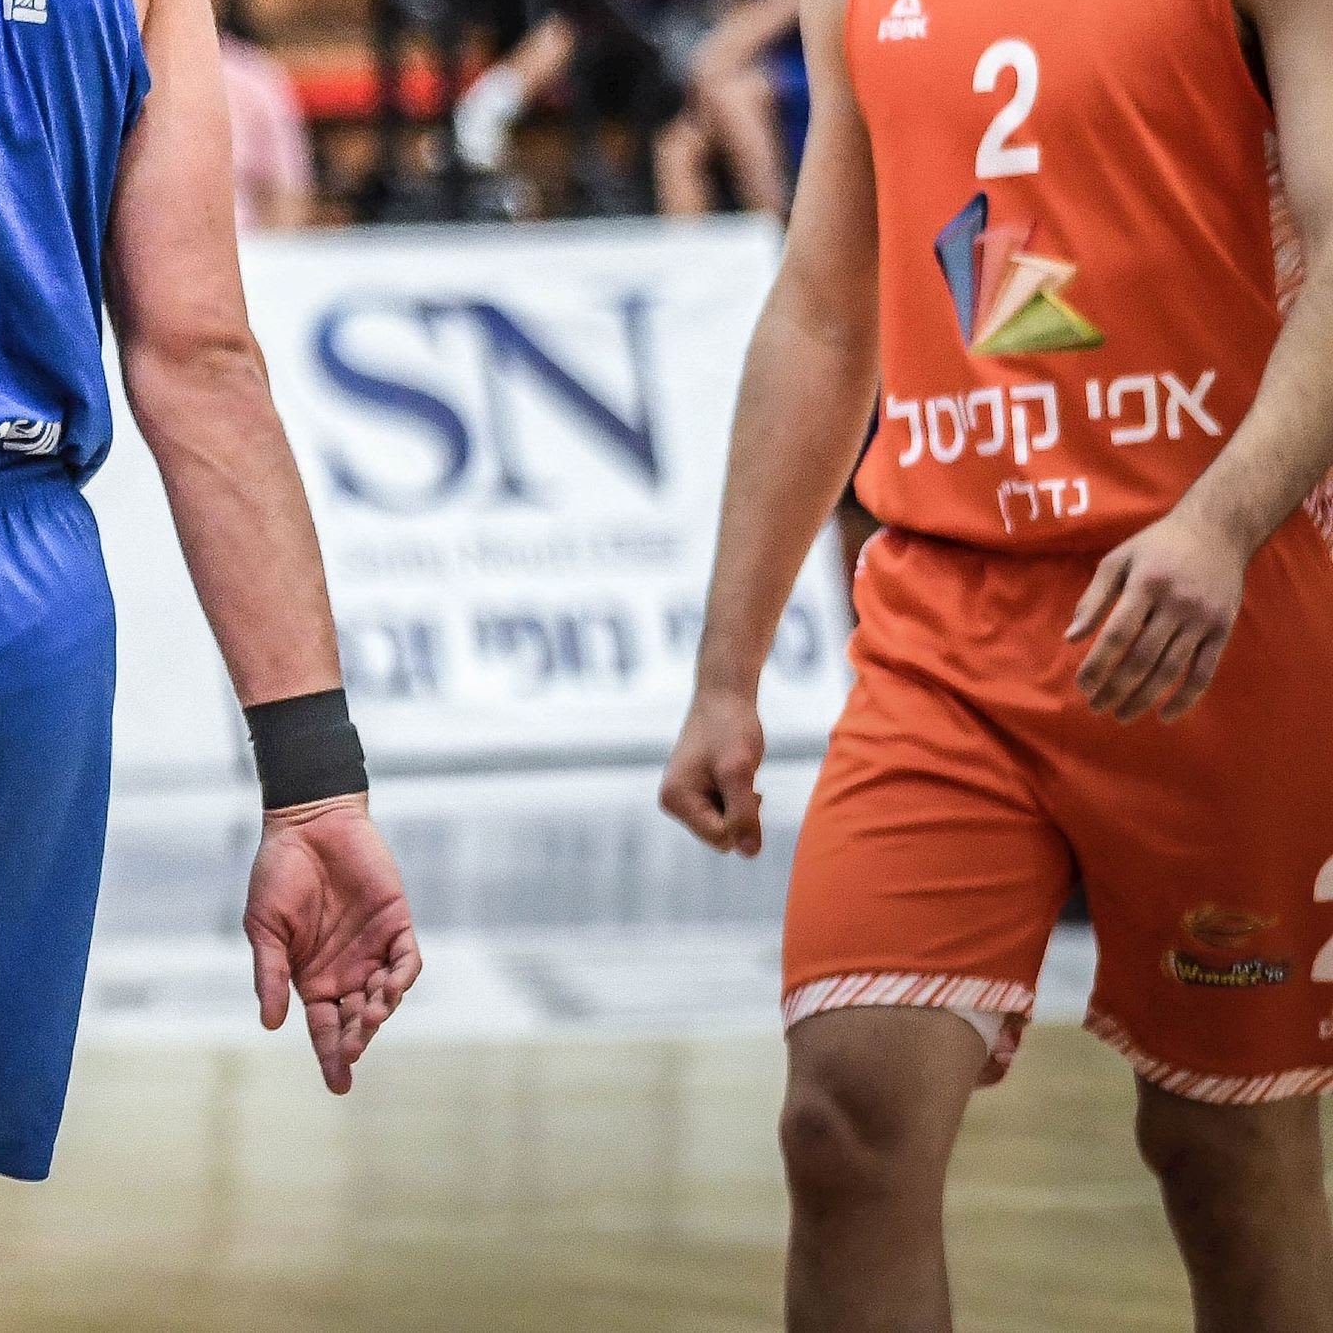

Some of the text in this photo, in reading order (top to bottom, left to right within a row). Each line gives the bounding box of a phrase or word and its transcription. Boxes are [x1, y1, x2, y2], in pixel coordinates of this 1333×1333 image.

[972, 38, 1041, 180] 2
[308, 279, 673, 512] SN
[1085, 369, 1223, 446] אפי
